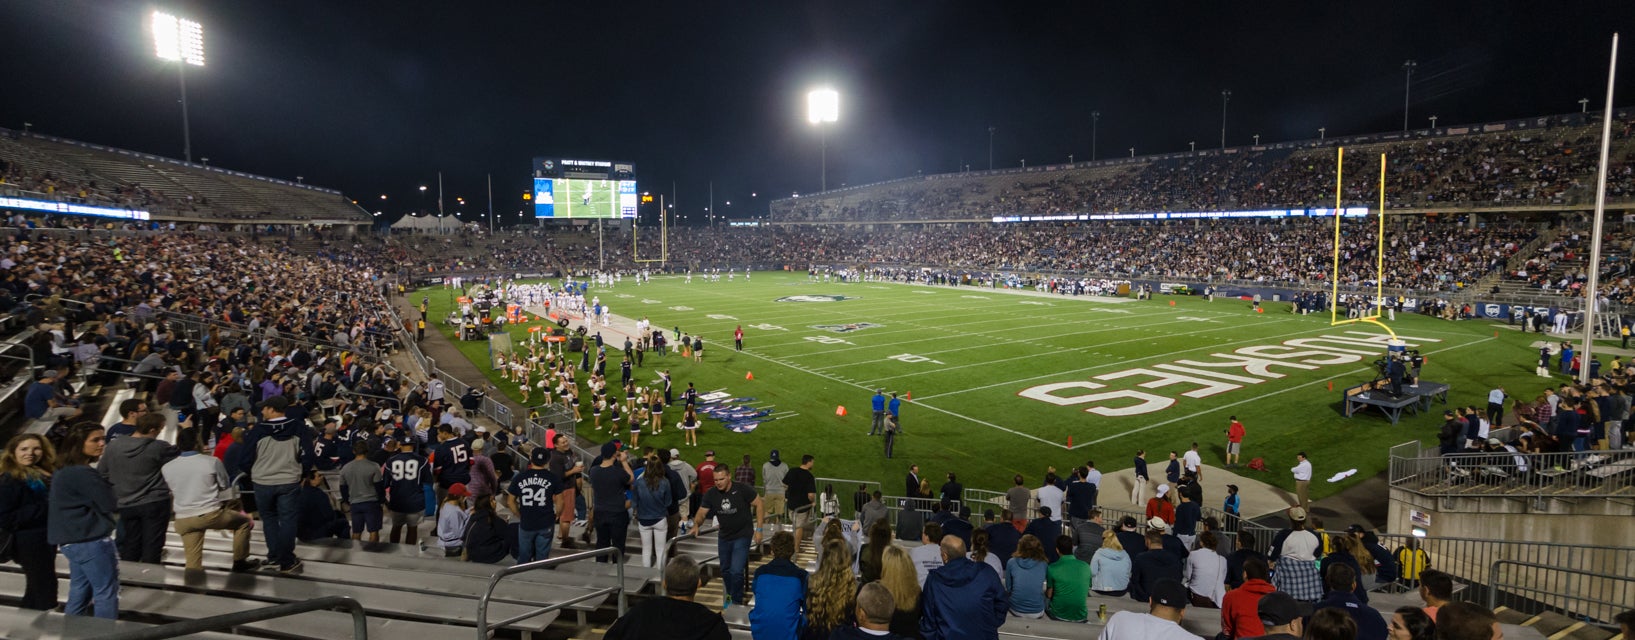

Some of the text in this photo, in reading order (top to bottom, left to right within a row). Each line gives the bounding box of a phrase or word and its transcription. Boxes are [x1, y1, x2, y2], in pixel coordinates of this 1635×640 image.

[887, 352, 930, 362] 10
[1017, 330, 1443, 417] HUSKIES
[450, 444, 468, 464] 15
[391, 459, 419, 481] 99
[518, 477, 552, 489] SANCHEZ
[522, 488, 546, 506] 24
